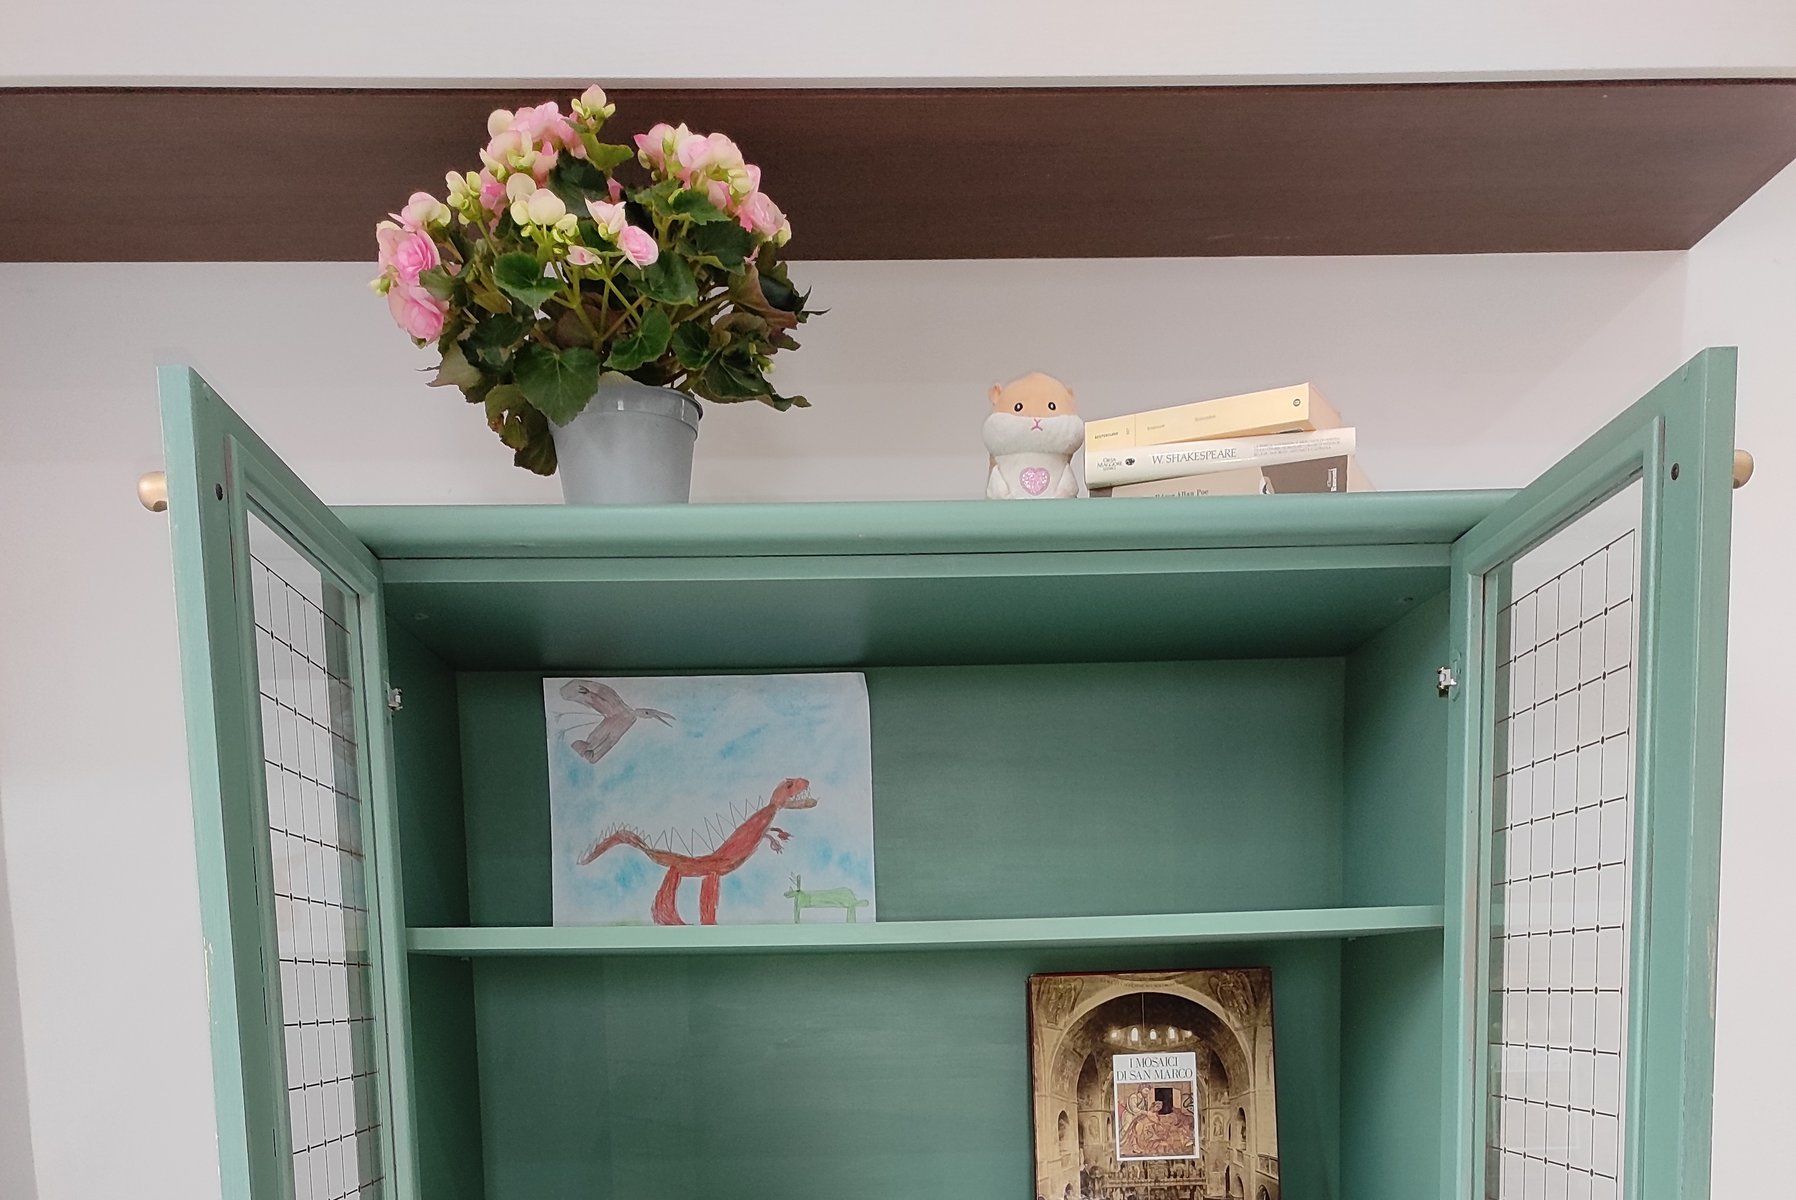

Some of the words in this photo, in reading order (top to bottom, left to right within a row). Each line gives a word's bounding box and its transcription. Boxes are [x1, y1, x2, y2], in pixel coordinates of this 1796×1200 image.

[1166, 448, 1237, 464] SHAKESPEARE
[1197, 489, 1209, 497] Poe
[1136, 1056, 1179, 1068] MOSAICI
[1116, 1070, 1127, 1081] DI
[1129, 1069, 1151, 1080] SAN
[1154, 1067, 1193, 1080] MARCO
